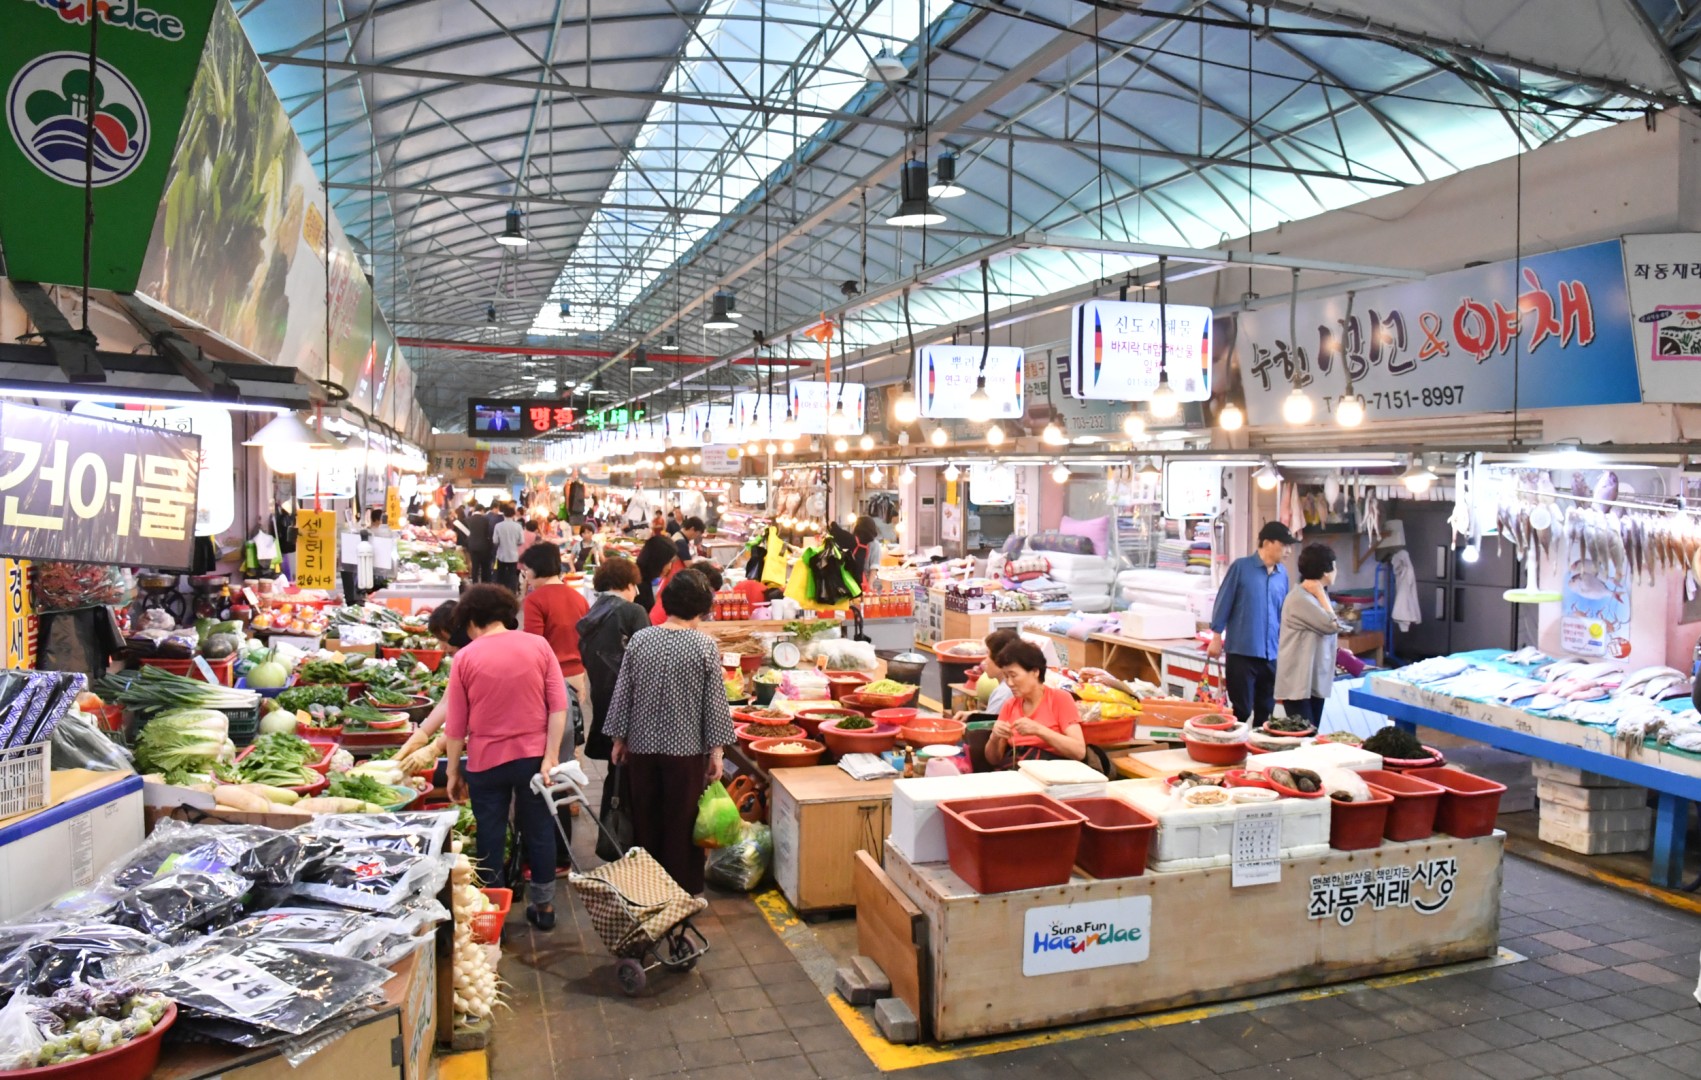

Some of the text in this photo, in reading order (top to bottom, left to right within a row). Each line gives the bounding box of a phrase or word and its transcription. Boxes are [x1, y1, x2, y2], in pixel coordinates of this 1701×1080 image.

[0, 436, 195, 541] 건어물
[1312, 866, 1411, 890] 행복한 밥상을 책임지는
[1033, 923, 1142, 954] Haeundae
[1051, 922, 1107, 936] Sun&Fun
